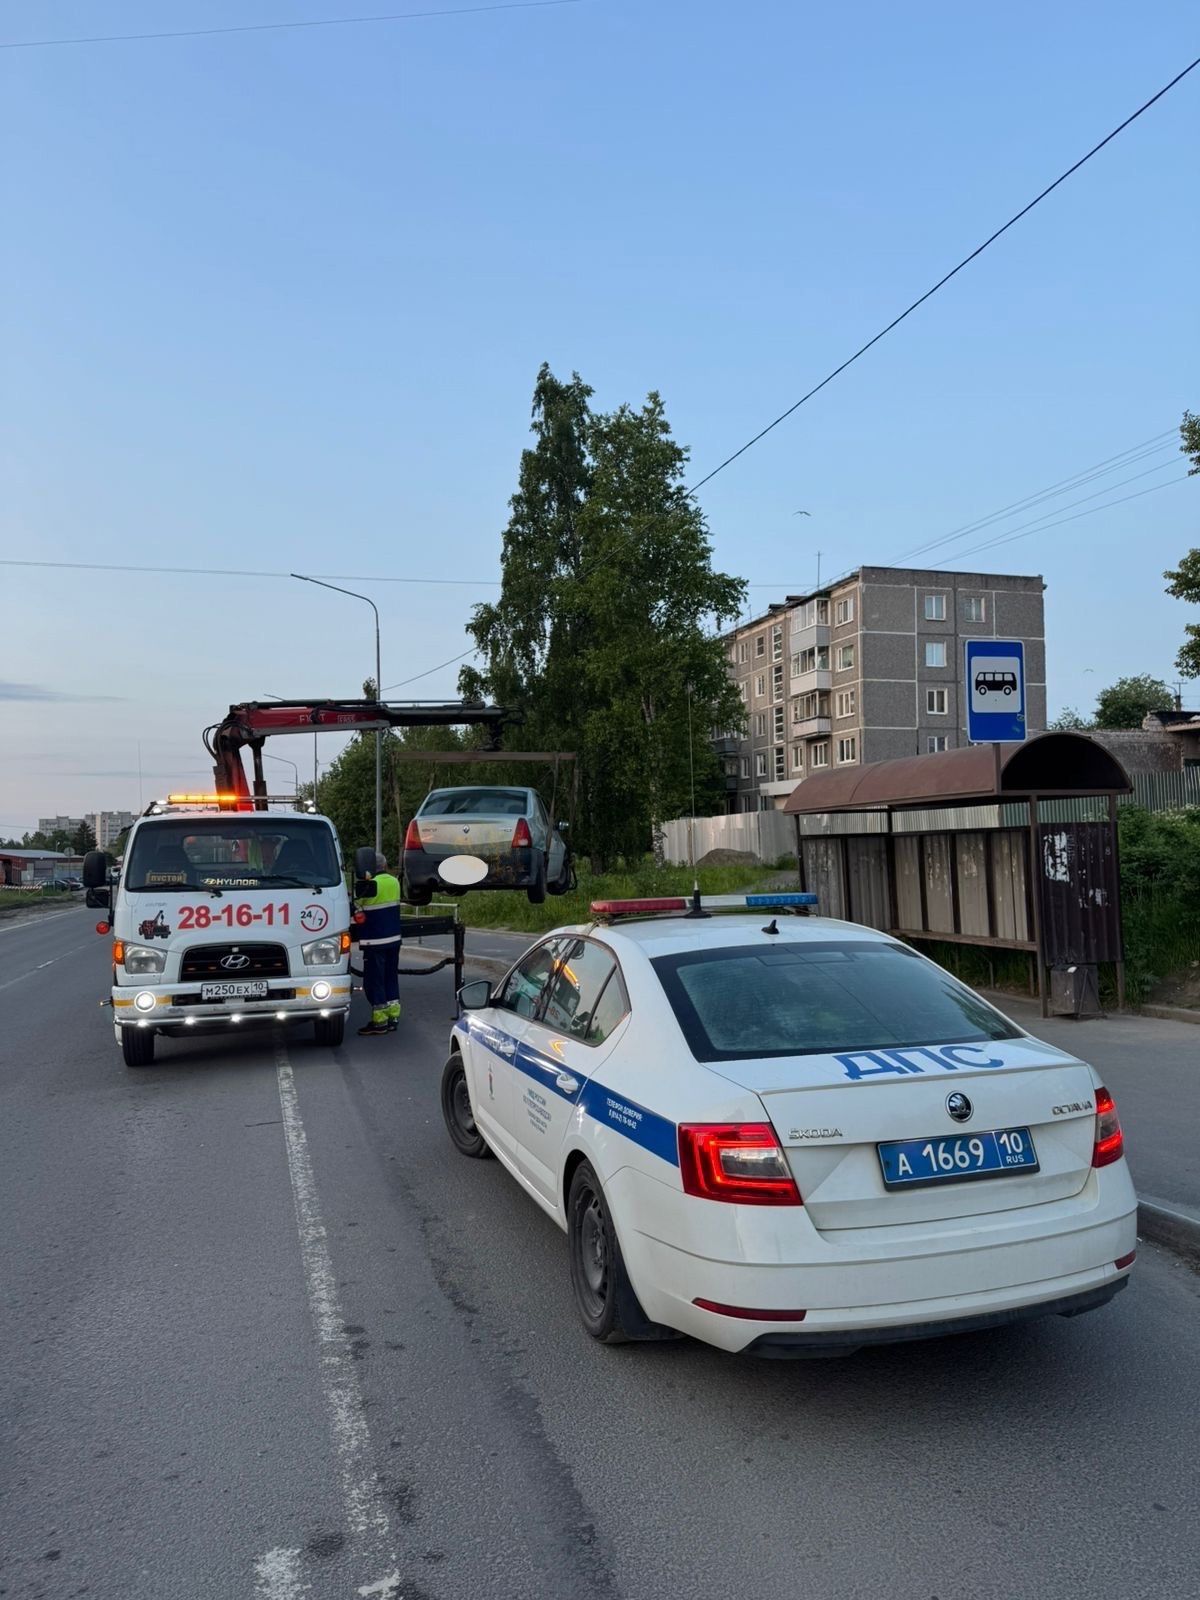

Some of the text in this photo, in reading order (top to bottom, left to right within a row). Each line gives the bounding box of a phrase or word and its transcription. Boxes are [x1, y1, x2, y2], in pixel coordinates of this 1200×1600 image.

[177, 903, 289, 929] 28-16-11
[253, 982, 264, 991] 10
[833, 1046, 1004, 1080] ДПС
[1051, 1100, 1093, 1116] OCTAVIA
[922, 1138, 985, 1172] 1669
[999, 1132, 1024, 1155] 10
[1006, 1154, 1026, 1164] RUS
